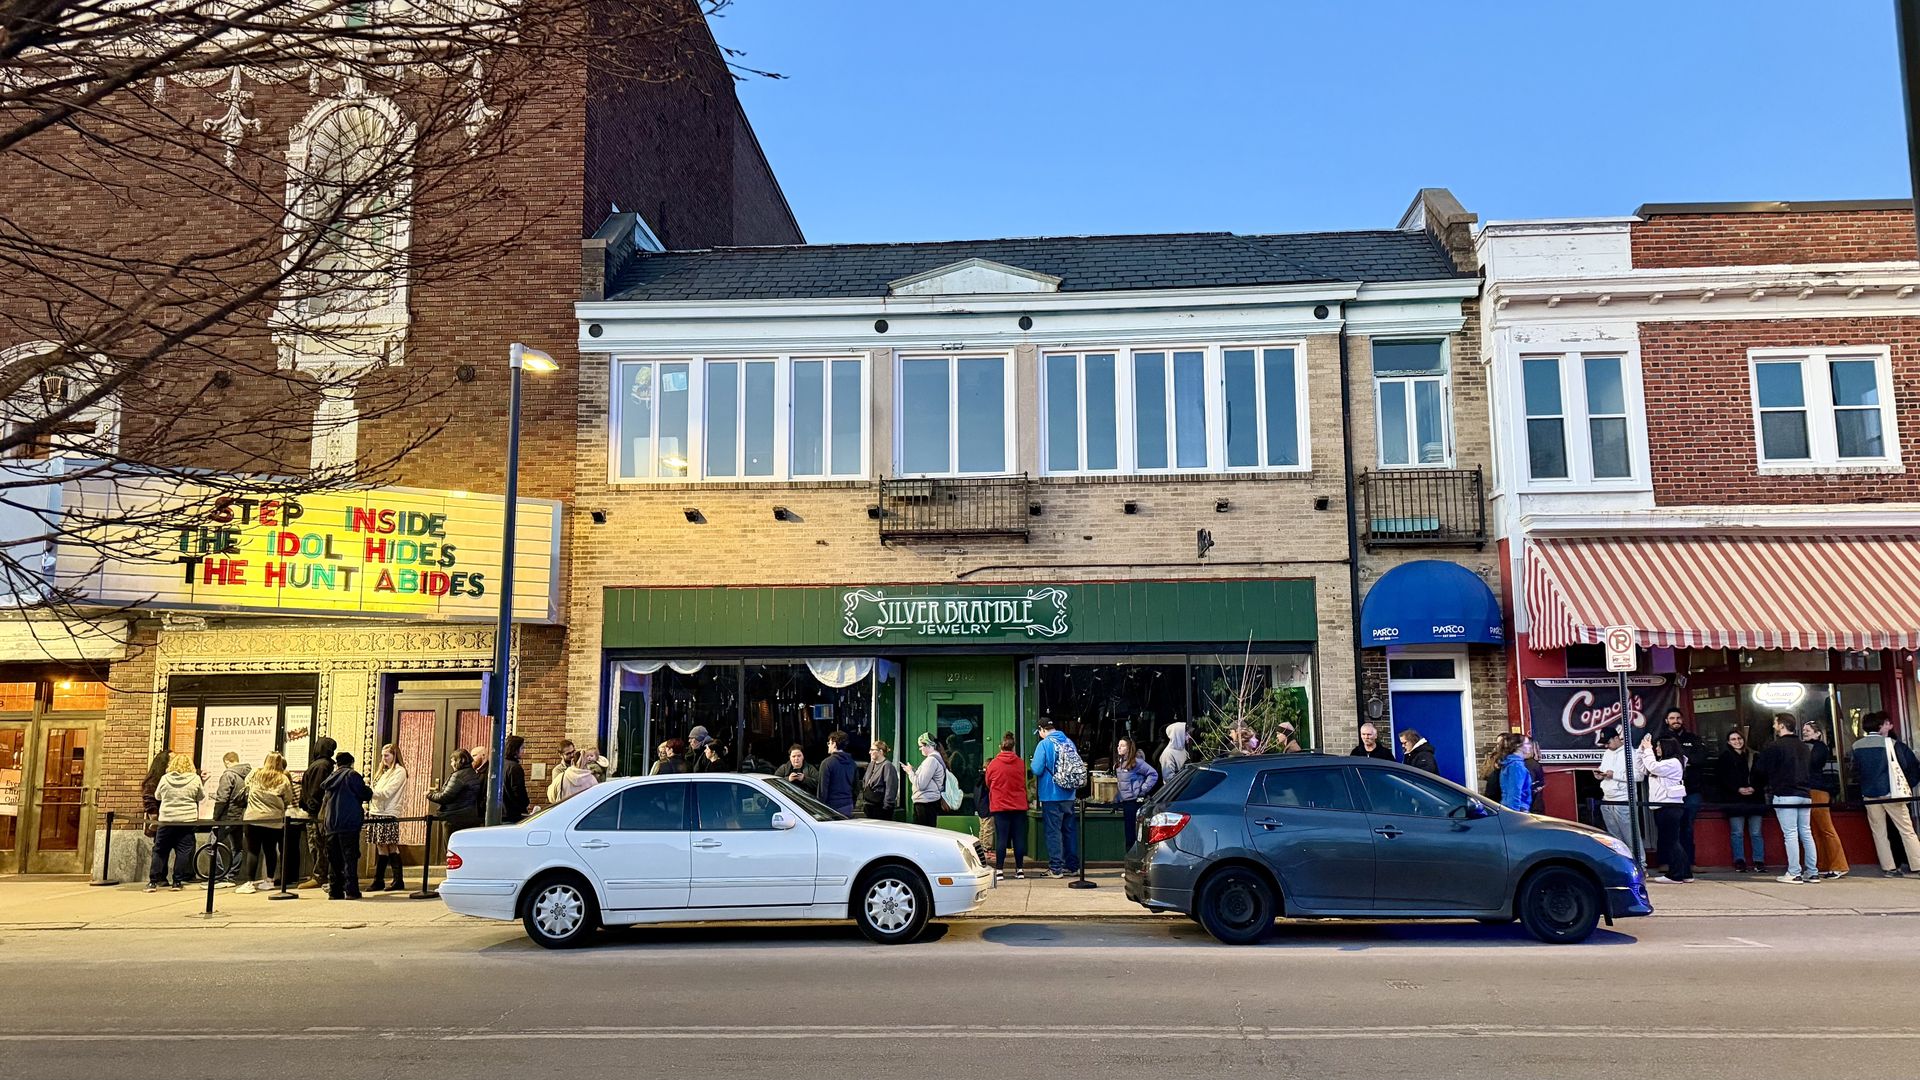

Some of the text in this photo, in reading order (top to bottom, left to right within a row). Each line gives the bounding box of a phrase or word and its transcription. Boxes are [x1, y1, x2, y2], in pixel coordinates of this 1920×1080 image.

[209, 496, 447, 538] STEP INSIDE
[179, 526, 457, 568] THE IDOL HIDES
[178, 556, 485, 600] THE HUNT ABIDES
[877, 600, 1034, 625] SILVER BRAMBLE
[918, 624, 992, 635] JEWELRY
[1372, 627, 1399, 637] PARCO
[1432, 624, 1465, 634] PARCO
[211, 716, 273, 727] FEBRUARY
